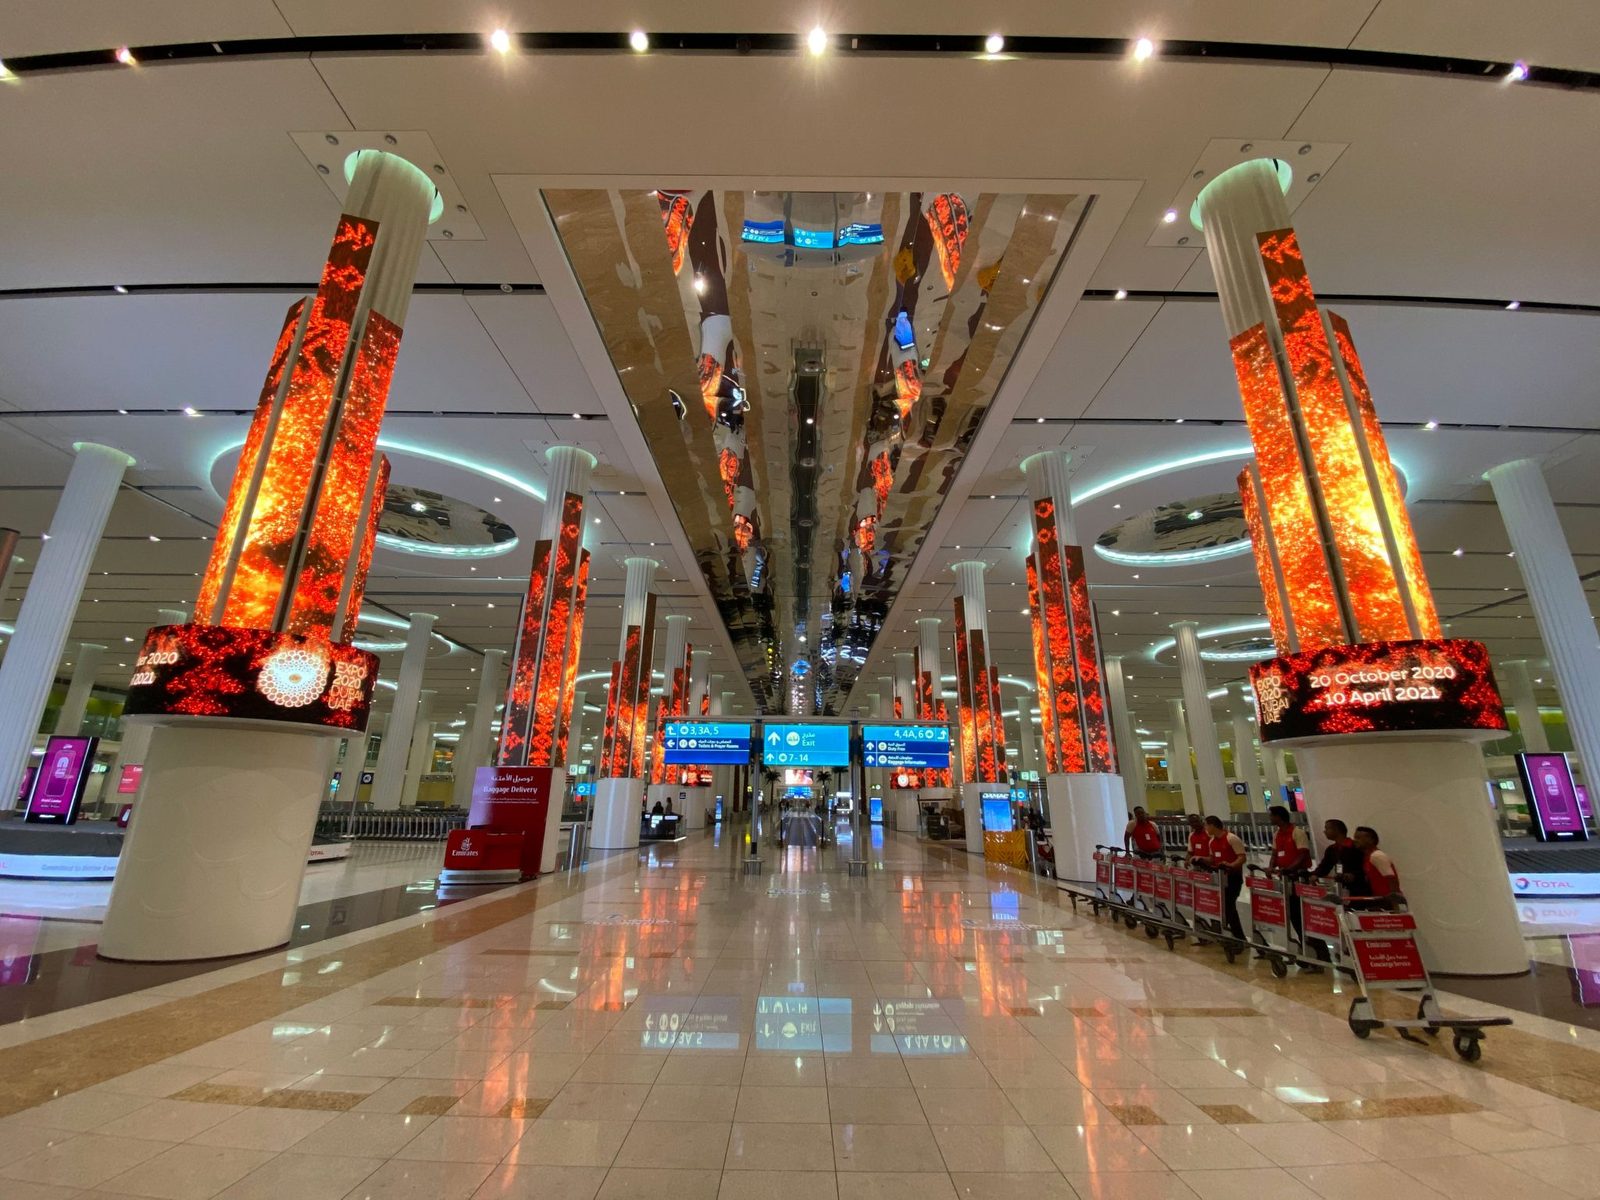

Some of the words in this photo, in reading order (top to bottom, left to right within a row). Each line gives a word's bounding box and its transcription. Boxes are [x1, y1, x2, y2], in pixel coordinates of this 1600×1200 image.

[147, 652, 178, 665] 2020
[336, 661, 366, 680] EXPO
[1309, 675, 1331, 689] 20
[1335, 668, 1407, 685] October
[1411, 666, 1455, 681] 2020
[332, 673, 361, 689] 2020
[1257, 676, 1281, 691] EXPO
[331, 684, 365, 701] DUBAI
[1325, 692, 1346, 706] 10
[1351, 687, 1392, 708] April
[1395, 686, 1441, 701] 2021
[328, 697, 351, 711] UAE
[1261, 697, 1289, 713] DUBAI
[1264, 711, 1281, 724] UAE
[713, 726, 719, 735] 5
[918, 730, 924, 738] 6
[483, 786, 510, 794] Baggage
[511, 785, 538, 795] Delivery
[451, 849, 479, 857] Emirates
[1532, 880, 1575, 888] TOTAL
